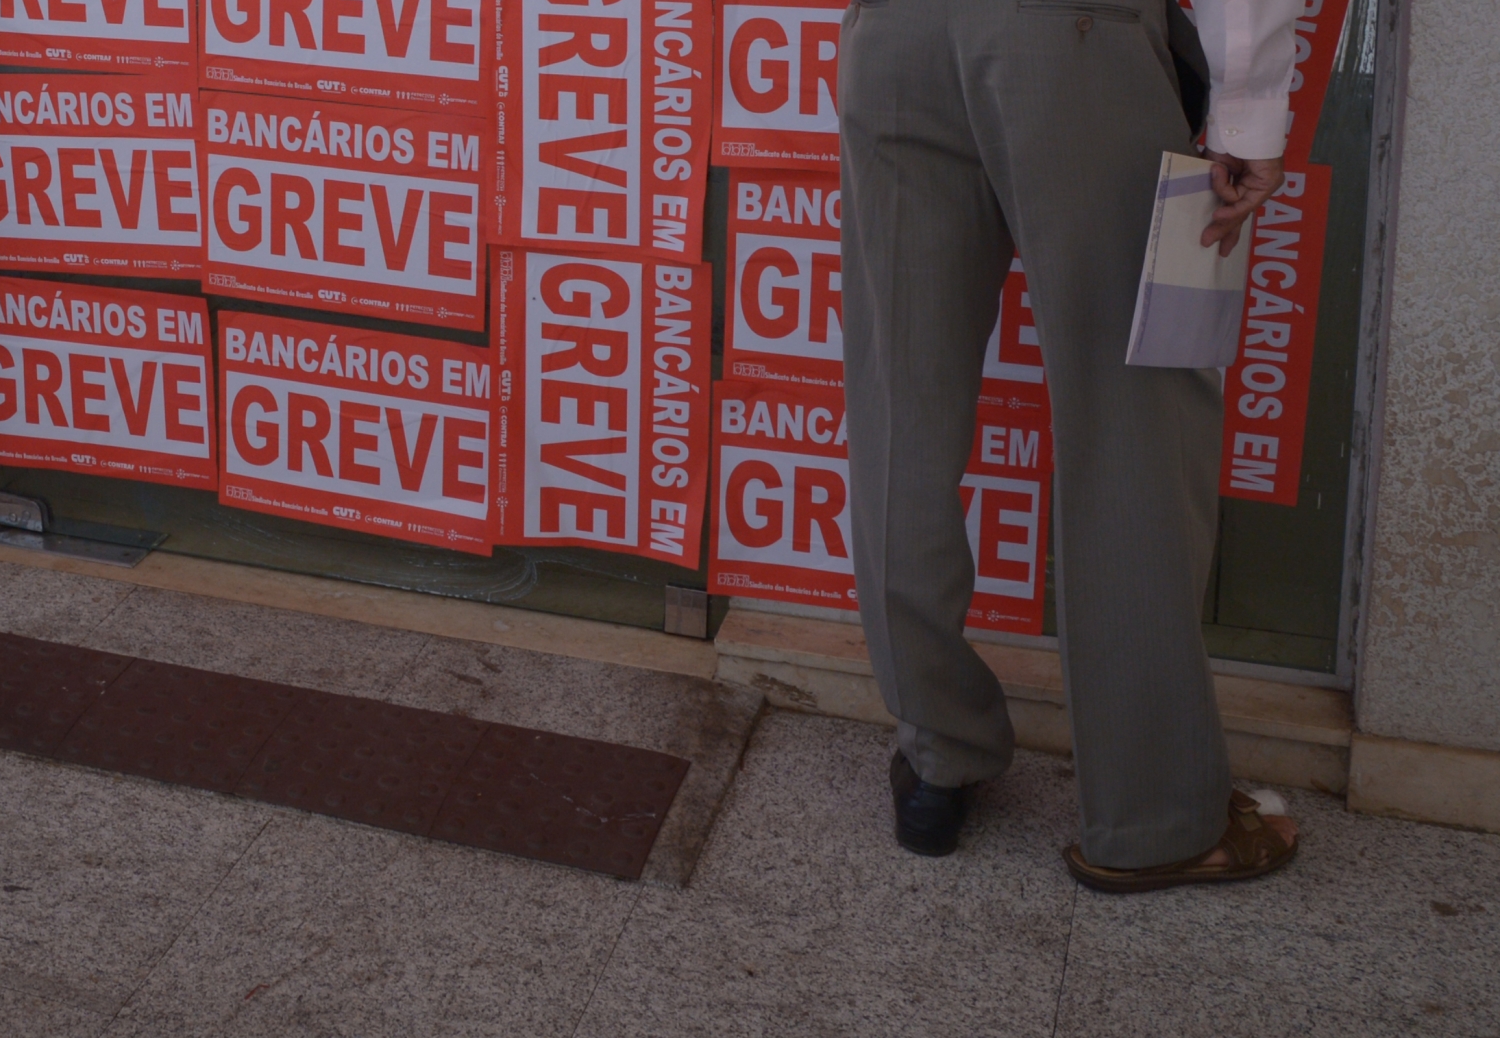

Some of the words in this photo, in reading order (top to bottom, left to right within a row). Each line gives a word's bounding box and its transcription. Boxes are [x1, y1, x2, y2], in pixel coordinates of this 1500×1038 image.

[146, 93, 192, 126] EM
[317, 79, 340, 91] CUT
[208, 109, 414, 163] BANCÁRIOS
[428, 132, 479, 170] EM
[213, 167, 472, 280] GREVE
[654, 195, 688, 251] EM
[318, 289, 340, 301] CUT
[1239, 172, 1305, 418] BANCÁRIOS
[158, 309, 202, 344] EM
[226, 328, 429, 388] BANCÁRIOS
[443, 359, 490, 398] EM
[652, 266, 699, 487] BANCÁRIOS
[540, 263, 630, 539] GREVE
[231, 385, 486, 503] GREVE
[982, 426, 1038, 466] EM
[1231, 433, 1278, 492] EM
[651, 500, 686, 555] EM
